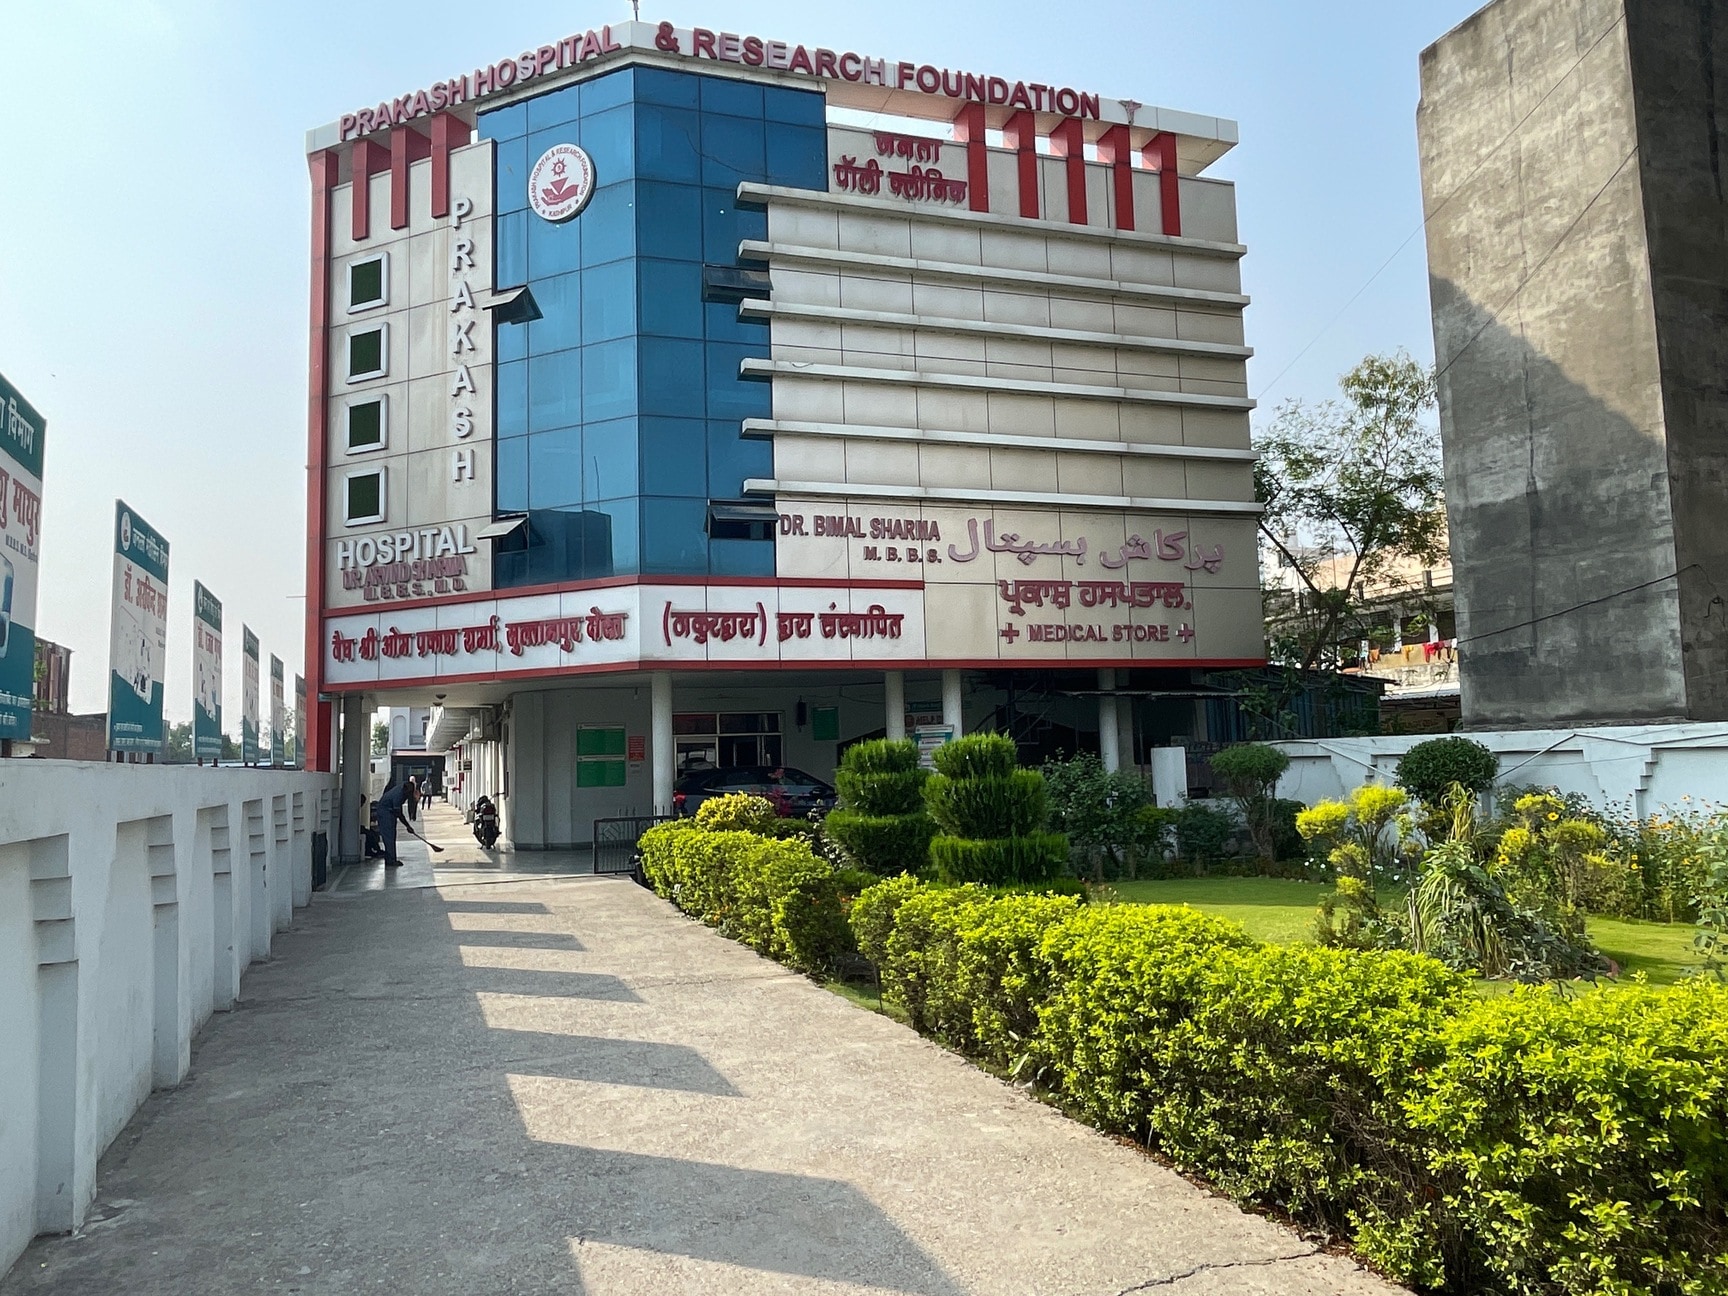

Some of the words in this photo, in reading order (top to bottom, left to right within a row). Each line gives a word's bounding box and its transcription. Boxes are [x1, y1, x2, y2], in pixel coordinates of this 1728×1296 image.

[339, 74, 467, 142] PRAKASH
[474, 24, 621, 97] HOSPITAL
[655, 21, 680, 53] &
[693, 27, 886, 87] RESEARCH
[898, 61, 1100, 121] FOUNDATION
[873, 130, 943, 164] जनता
[833, 155, 884, 195] पॉली
[451, 196, 476, 483] PRAKASH
[780, 514, 809, 537] DR.
[813, 515, 867, 539] BIMAL
[870, 518, 940, 542] SHARMA
[337, 524, 477, 571] HOSPITAL
[364, 561, 412, 587] ARVIND
[411, 554, 468, 581] SHARMA
[359, 626, 381, 661] श्री
[381, 626, 415, 659] ओम
[416, 628, 461, 658] प्रकाश
[1026, 623, 1108, 643] MEDICAL
[1113, 623, 1170, 643] STORE
